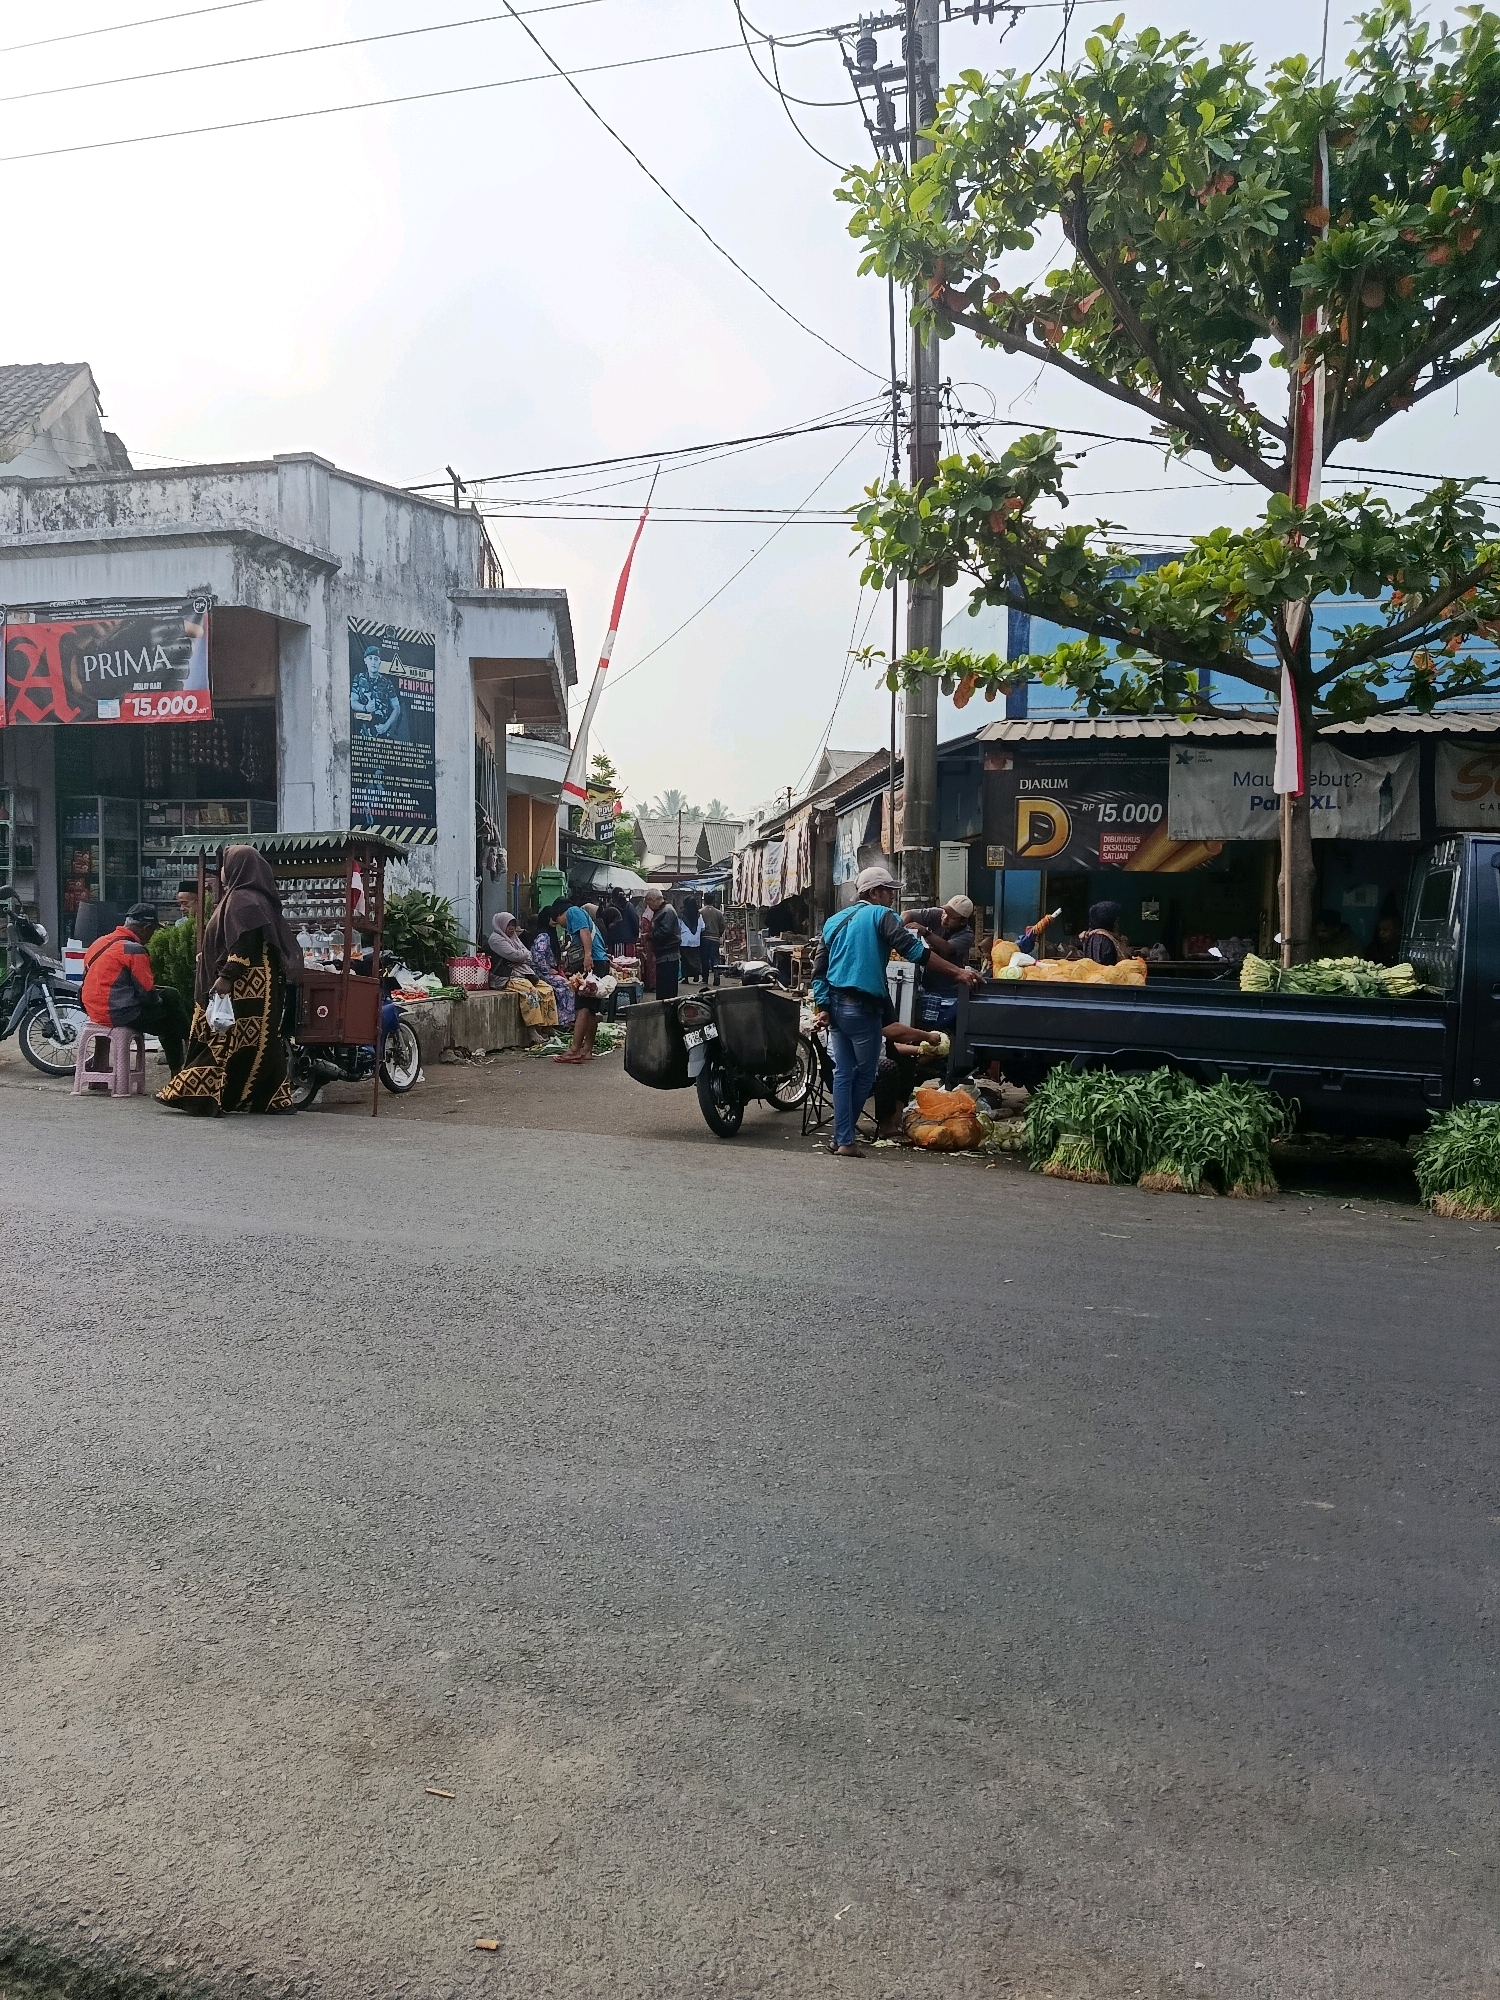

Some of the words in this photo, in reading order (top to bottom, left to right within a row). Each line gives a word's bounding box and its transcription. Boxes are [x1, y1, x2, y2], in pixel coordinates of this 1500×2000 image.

[83, 644, 172, 682] PRIMA
[398, 678, 434, 694] PENIPUAN
[131, 695, 197, 716] 15.000
[1019, 778, 1069, 791] DJARUM
[1309, 770, 1363, 788] ebut?
[1451, 753, 1500, 801] S
[1082, 803, 1095, 811] RP
[1097, 803, 1163, 823] 15.000
[1102, 844, 1138, 852] EKSKLUSIF
[1103, 835, 1141, 844] DIBUNGKUS
[1102, 852, 1129, 860] SATUAN
